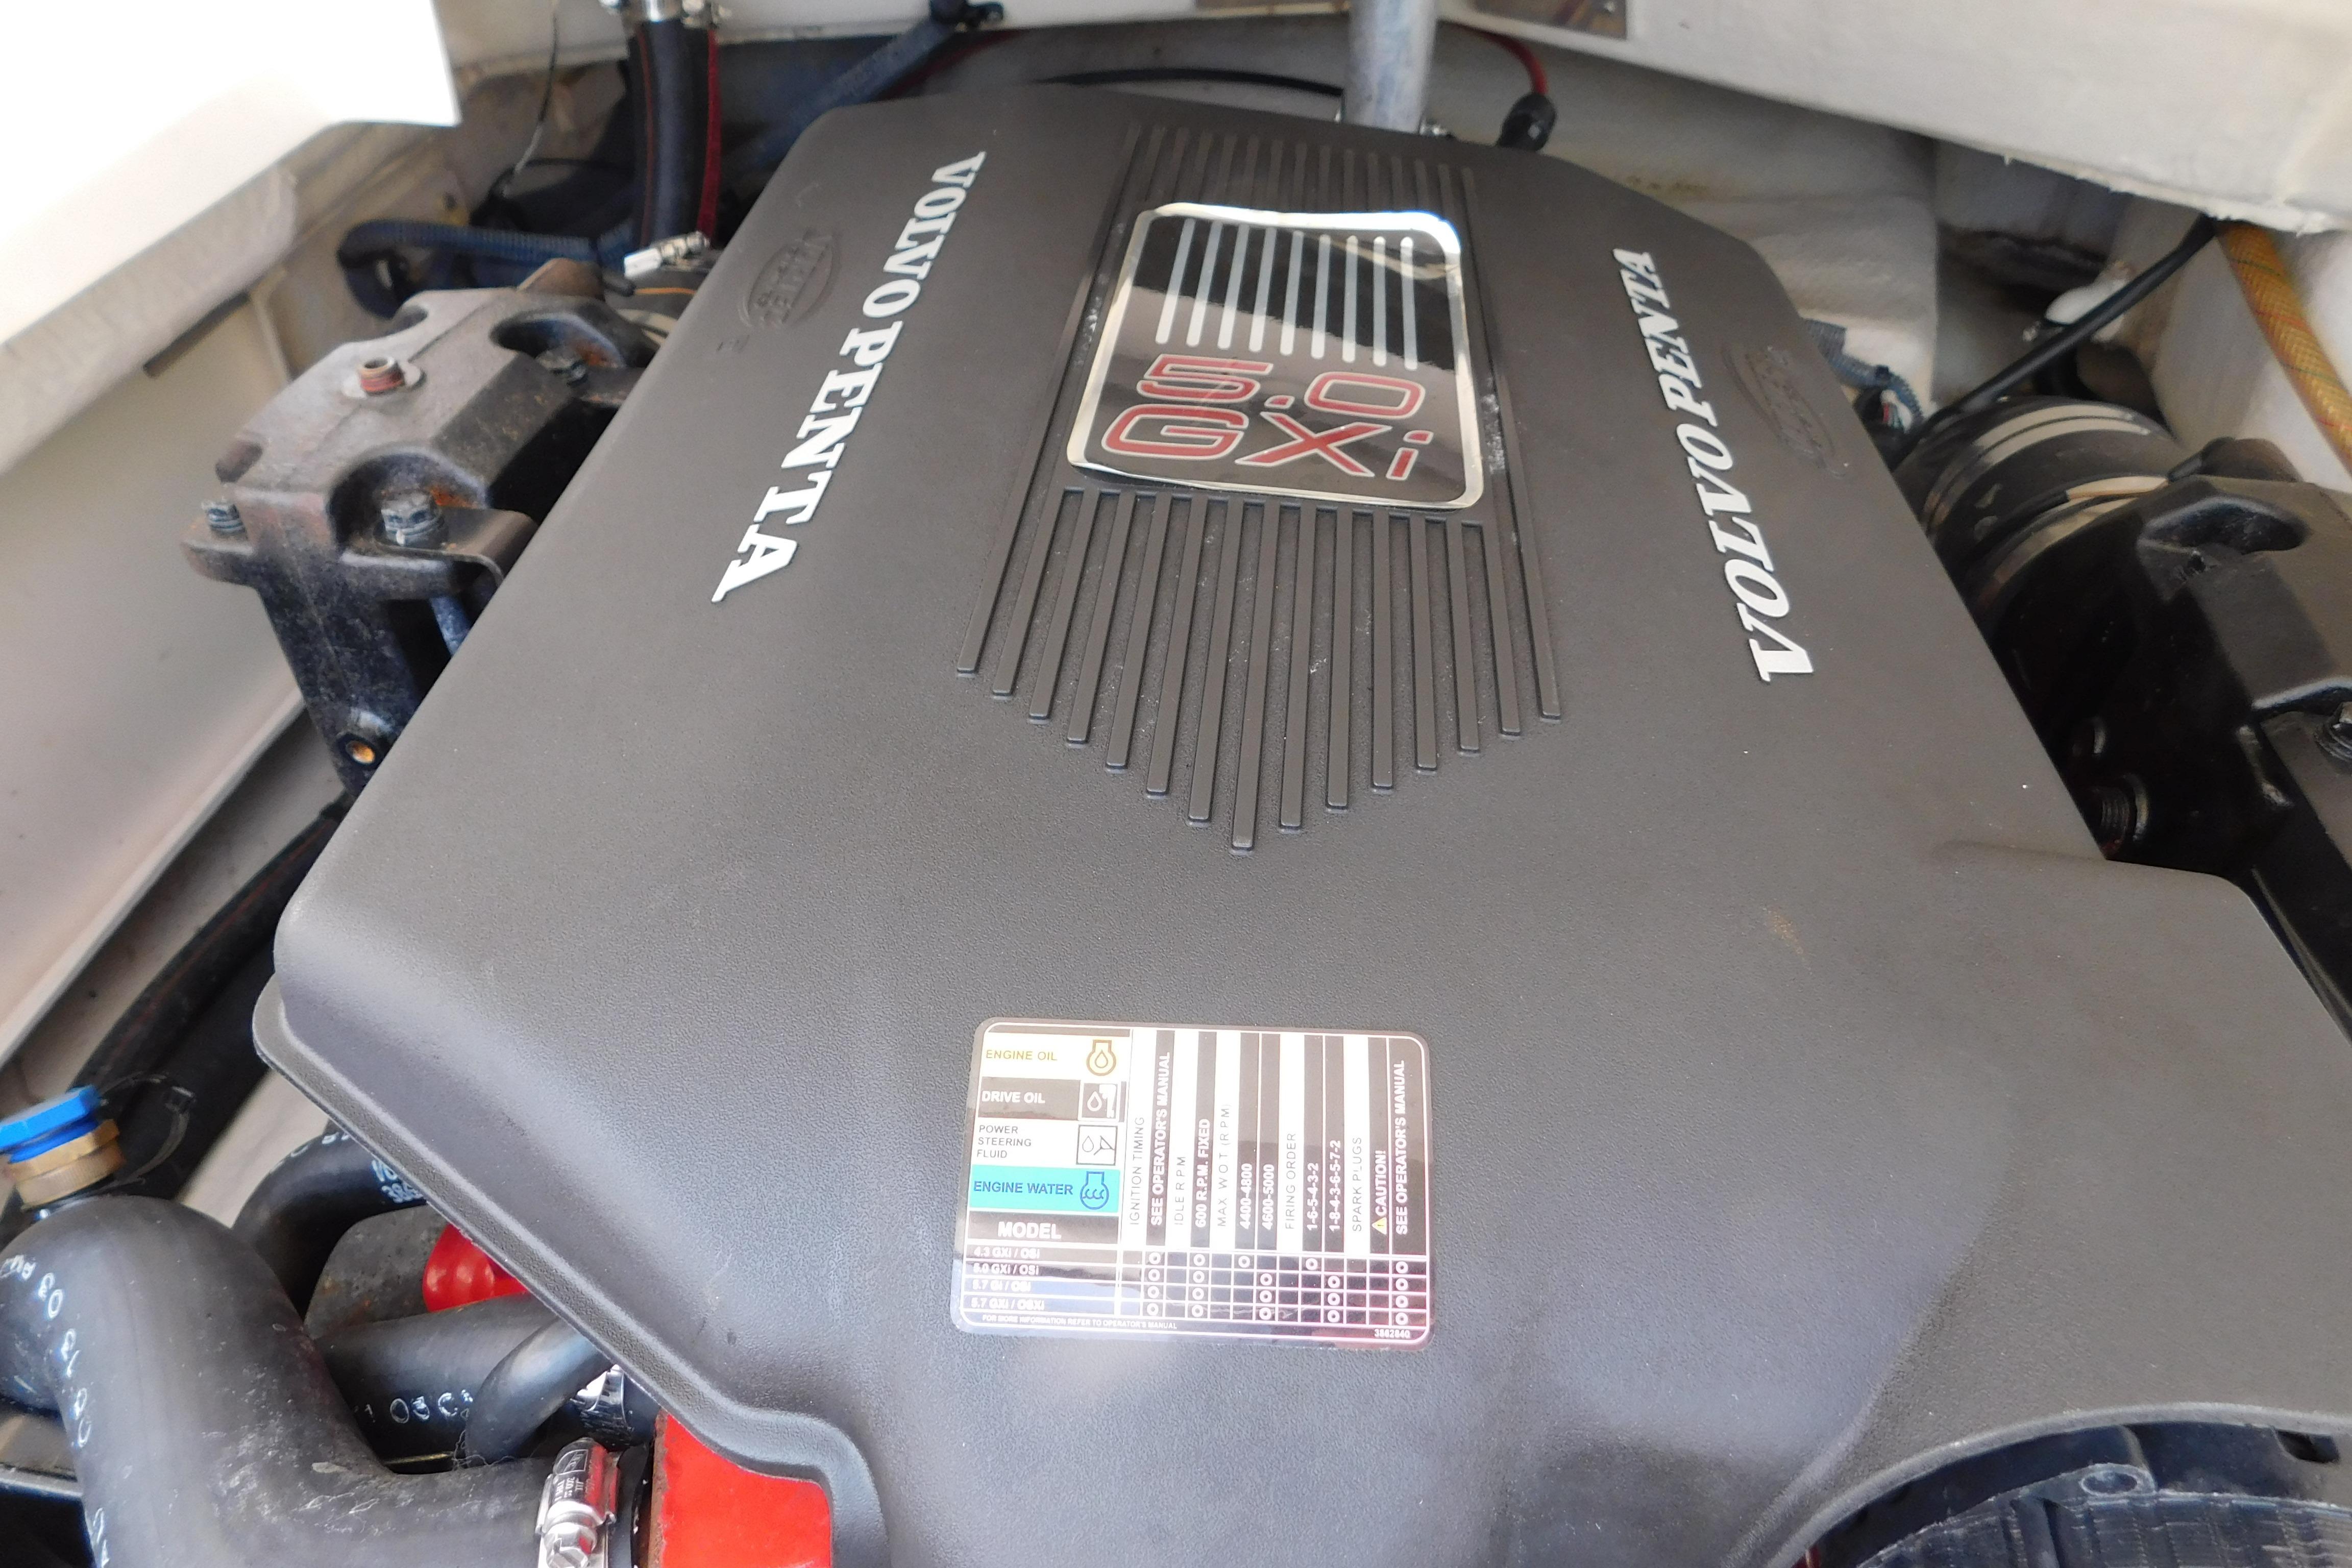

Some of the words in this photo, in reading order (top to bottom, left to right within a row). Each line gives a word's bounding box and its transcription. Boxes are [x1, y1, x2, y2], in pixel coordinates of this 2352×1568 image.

[862, 151, 987, 319] VOLVO
[1612, 248, 1718, 426] PENTA
[1136, 353, 1426, 420] 5.0
[712, 320, 903, 602] PENTA
[1101, 403, 1433, 481] GXi
[1675, 423, 1814, 682] VOLVO
[986, 1049, 1033, 1061] ENGINE
[1038, 1051, 1058, 1062] OIL
[981, 1091, 1021, 1103] DRIVE
[1023, 1092, 1046, 1104] OIL
[1157, 1052, 1170, 1106] MANUAL
[1394, 1060, 1406, 1114] MANUAL
[978, 1137, 1032, 1147] STEERING
[979, 1124, 1018, 1134] POWER
[1133, 1117, 1144, 1161] TIMING
[1197, 1119, 1210, 1158] FIXED
[976, 1149, 1008, 1159] FLUID
[1152, 1109, 1167, 1195] OPERATOR'S
[1286, 1133, 1296, 1180] ORDER
[1353, 1137, 1362, 1181] PLUGS
[1394, 1117, 1408, 1204] OPERATOR'S
[973, 1181, 1023, 1193] ENGINE
[1027, 1183, 1073, 1195] WATER
[1130, 1166, 1142, 1225] IGNITION
[1240, 1163, 1253, 1230] 4400-4800
[1262, 1164, 1275, 1231] 4600-5000
[1306, 1163, 1319, 1231] 1-6-5-4-3-2
[1329, 1140, 1341, 1233] 1-8-4-3-6-5-7-2
[1375, 1150, 1387, 1216] CAUTION!
[1150, 1197, 1163, 1226] SEE
[1174, 1195, 1185, 1225] IDLE
[1195, 1204, 1207, 1228] 600
[1217, 1197, 1227, 1227] MAX
[1285, 1185, 1295, 1229] FIRING
[1353, 1187, 1362, 1232] SPARK
[1396, 1206, 1408, 1235] SEE
[973, 1246, 990, 1257] 4.3
[997, 1221, 1062, 1239] MODEL
[1148, 1321, 1177, 1330] MANUAL
